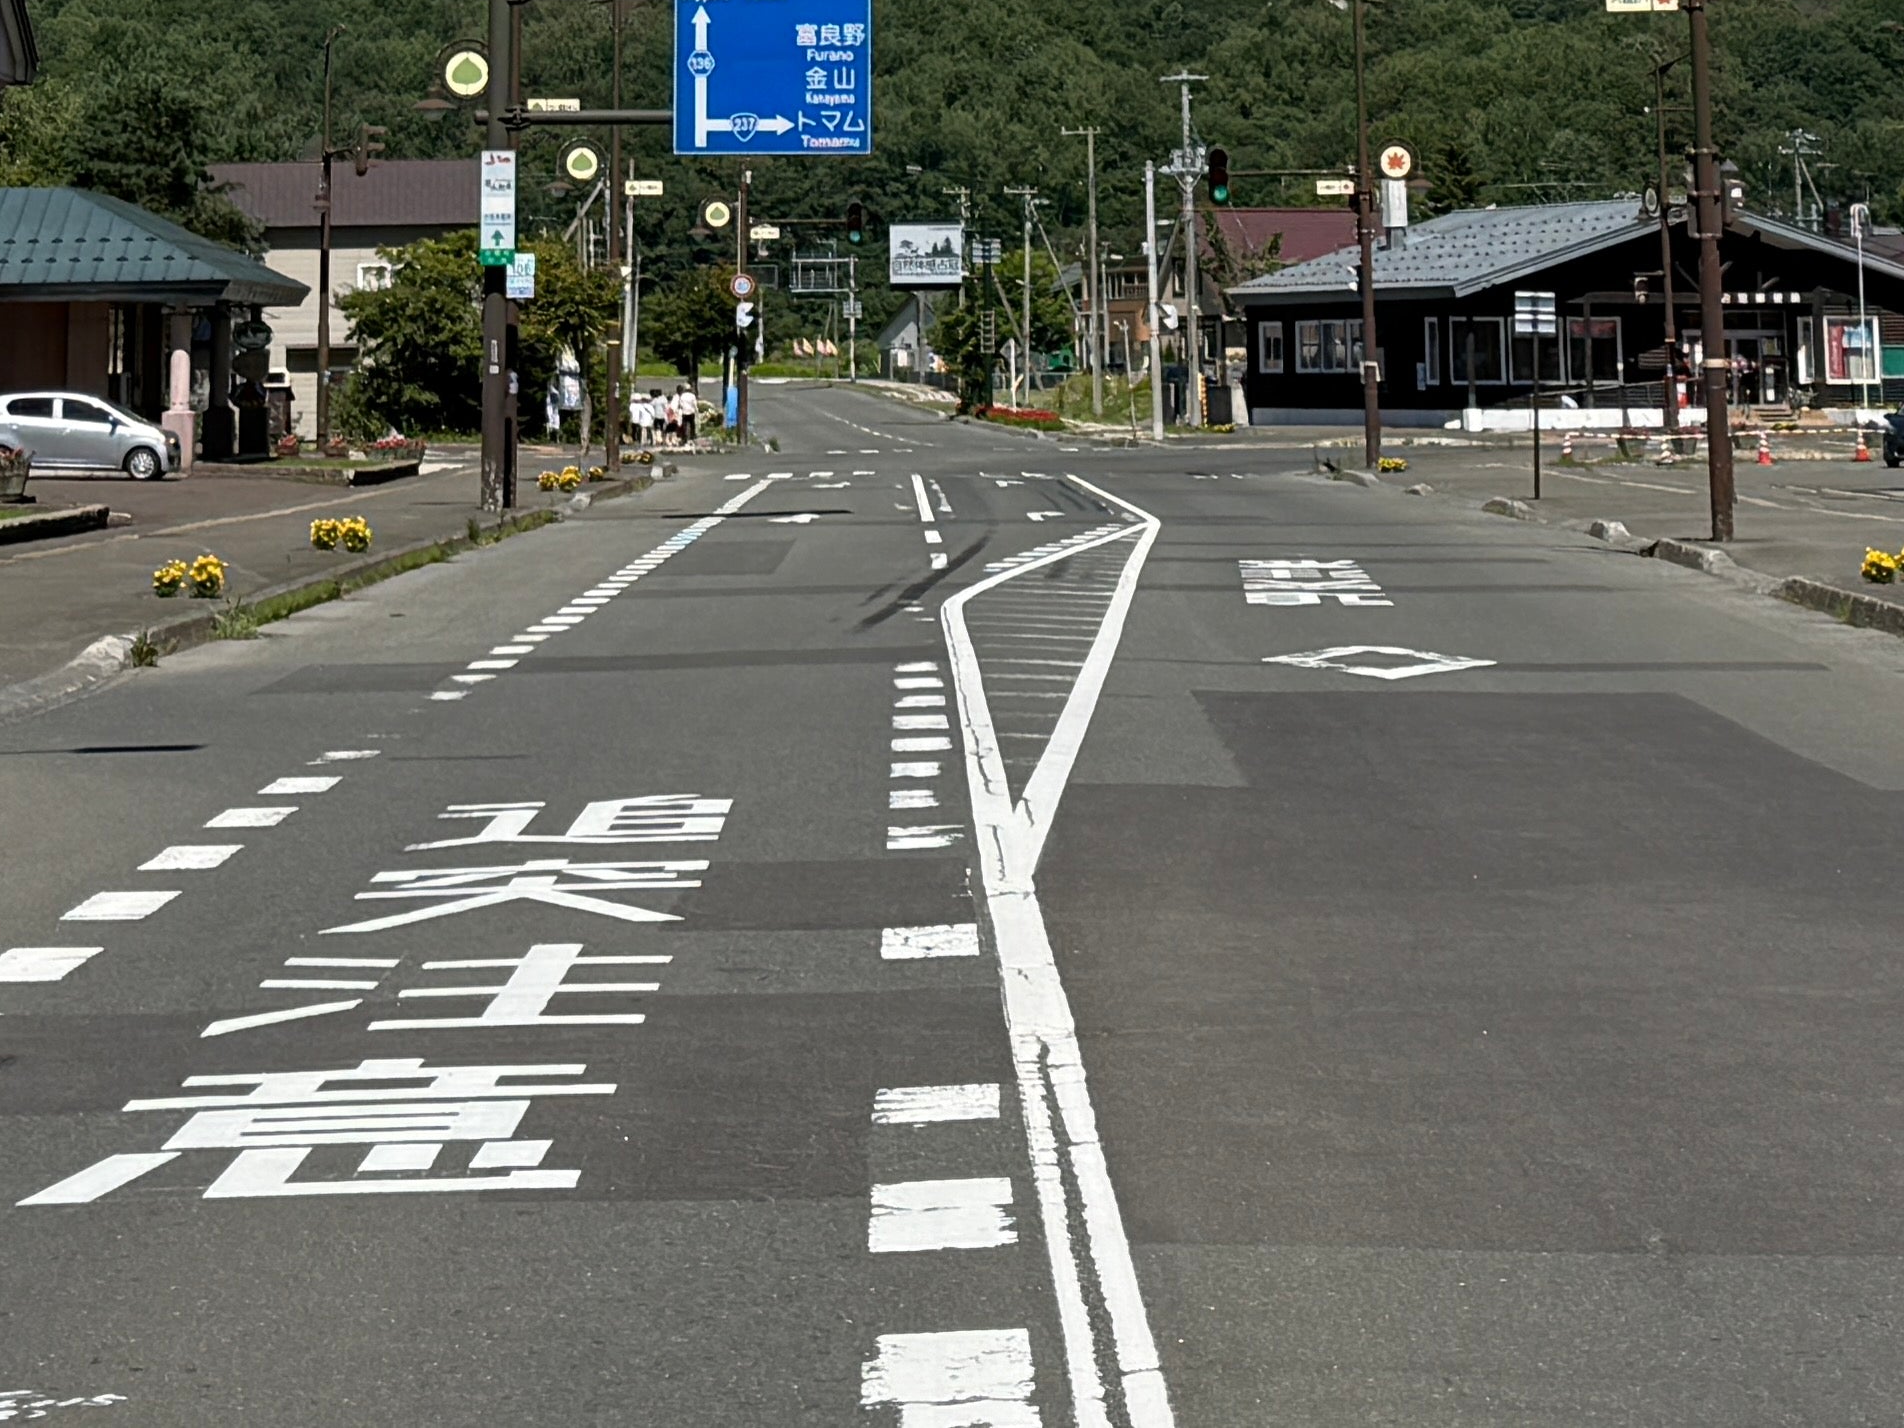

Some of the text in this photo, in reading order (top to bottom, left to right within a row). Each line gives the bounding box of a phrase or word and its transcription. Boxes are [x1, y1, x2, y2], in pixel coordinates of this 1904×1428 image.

[795, 23, 865, 46] 富良野
[692, 57, 710, 70] 136
[807, 49, 854, 62] Furano
[805, 66, 855, 89] 金山
[734, 118, 755, 131] 237
[798, 110, 865, 132] トマム
[16, 794, 733, 1206] 追突注意
